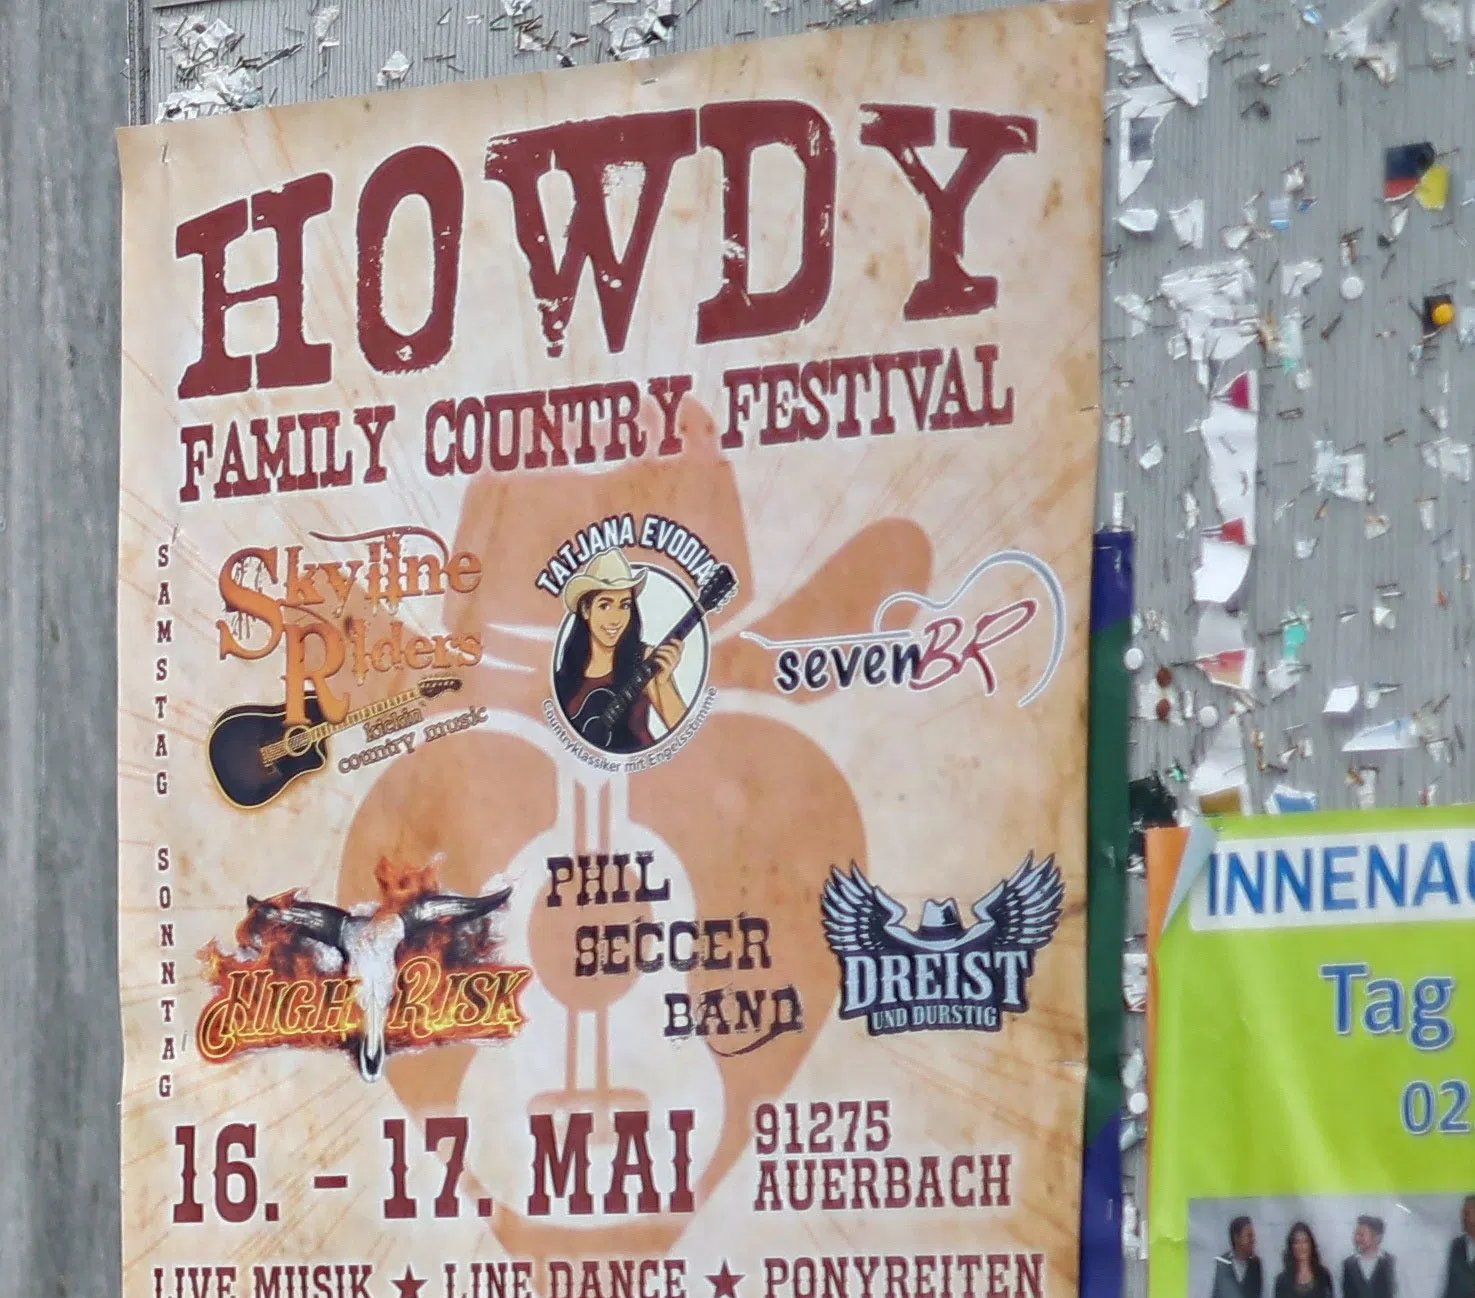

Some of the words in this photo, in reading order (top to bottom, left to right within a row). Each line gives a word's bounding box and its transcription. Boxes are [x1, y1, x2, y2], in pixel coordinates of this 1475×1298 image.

[176, 98, 1037, 400] HOWDY
[179, 405, 394, 502] FAMILY
[426, 374, 693, 478] COUNTRY
[720, 345, 1013, 450] FESTIVAL
[536, 514, 634, 597] TATJANA
[157, 545, 172, 795] SAMSTAG
[338, 730, 416, 776] country
[424, 705, 488, 743] music
[543, 700, 621, 773] Countryklassiker
[624, 757, 646, 774] mit
[648, 687, 718, 767] Engelsstimme
[545, 851, 671, 908] PHIL
[158, 848, 175, 1097] SONNTAG
[842, 949, 1029, 1012] DREIST
[1319, 962, 1456, 1050] Tag
[663, 984, 803, 1046] BAND
[872, 1009, 907, 1030] UND
[912, 1004, 997, 1028] DURSTIG
[173, 1122, 279, 1223] 16.
[383, 1117, 493, 1219] 17.
[527, 1109, 695, 1216] MAI
[754, 1101, 891, 1154] 91275
[754, 1154, 1014, 1211] AUERBACH
